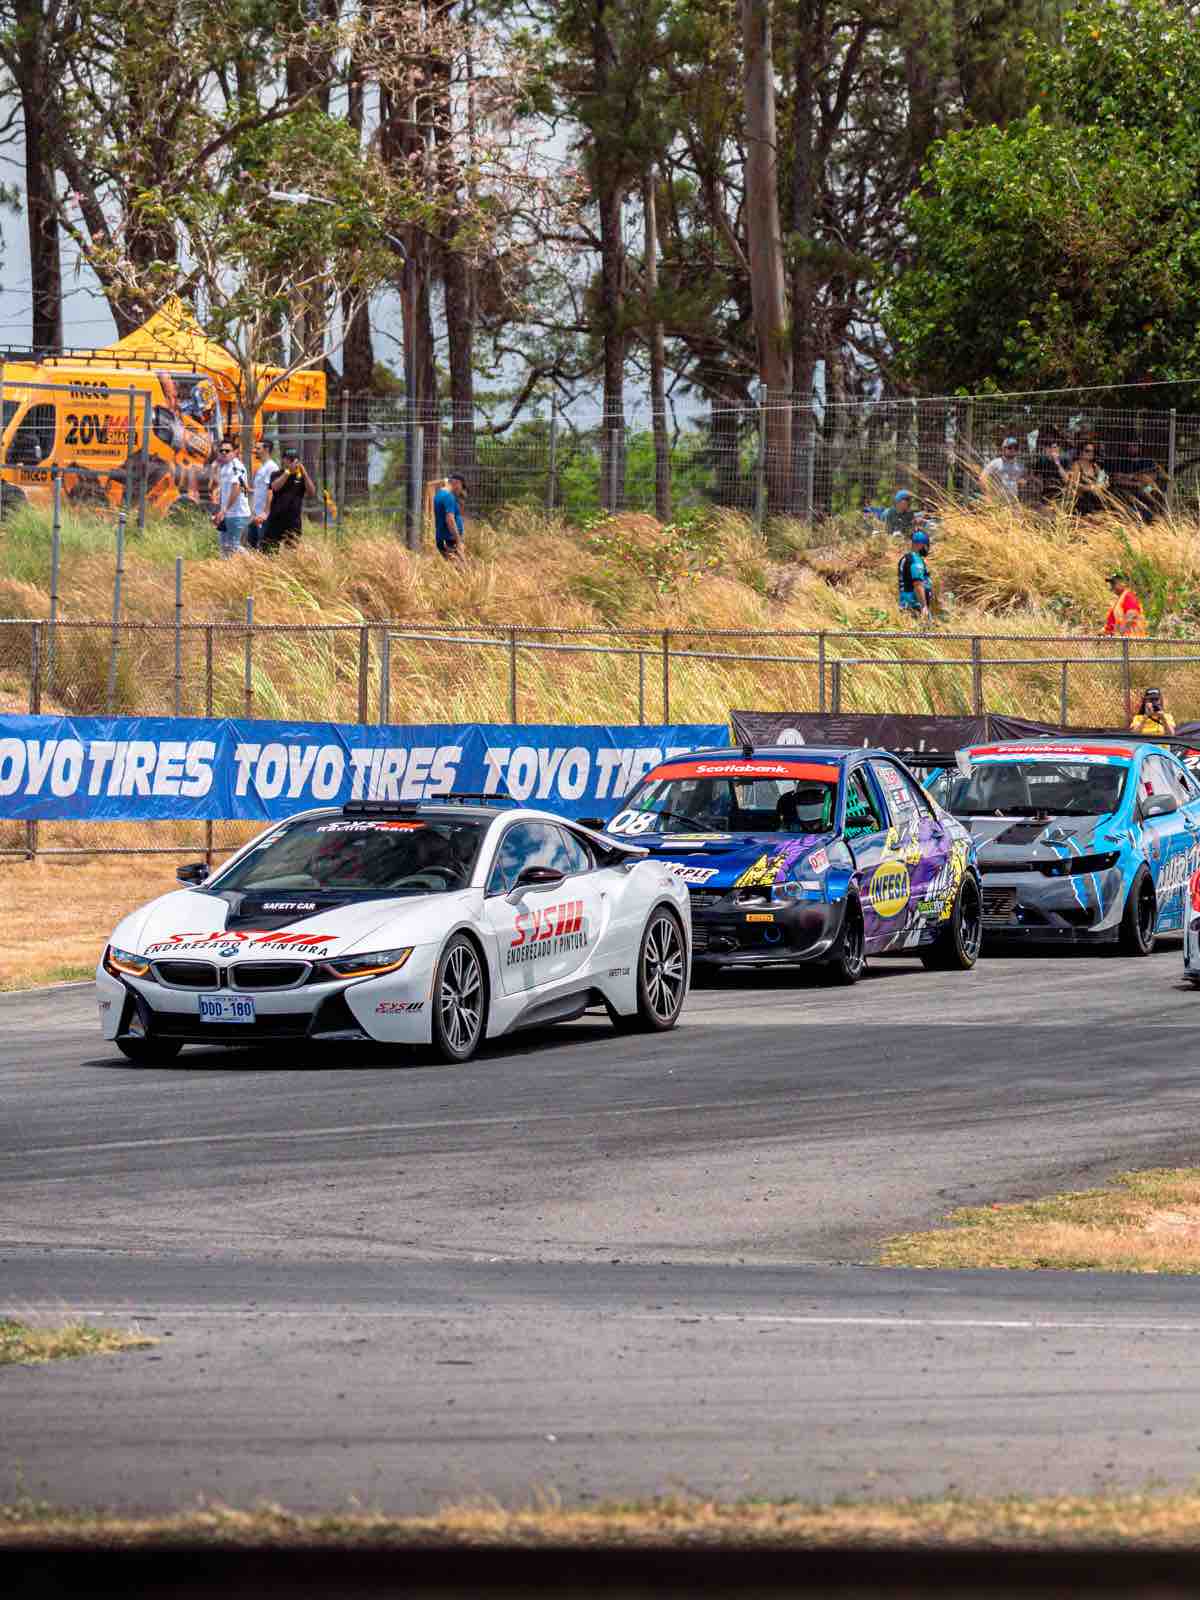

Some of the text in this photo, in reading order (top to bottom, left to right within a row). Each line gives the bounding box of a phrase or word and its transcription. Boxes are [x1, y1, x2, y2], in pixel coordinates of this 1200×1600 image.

[0, 737, 217, 798] OYO TIRES
[234, 742, 463, 800] TOYO TIRES
[484, 747, 692, 800] TOYO TIR
[606, 809, 658, 834] 08
[262, 902, 316, 910] SAFETY CAR
[143, 939, 241, 956] ENDEREZADO
[262, 942, 329, 957] PINTURA
[507, 940, 551, 966] ENDEREZADO
[559, 931, 588, 953] PINTURA
